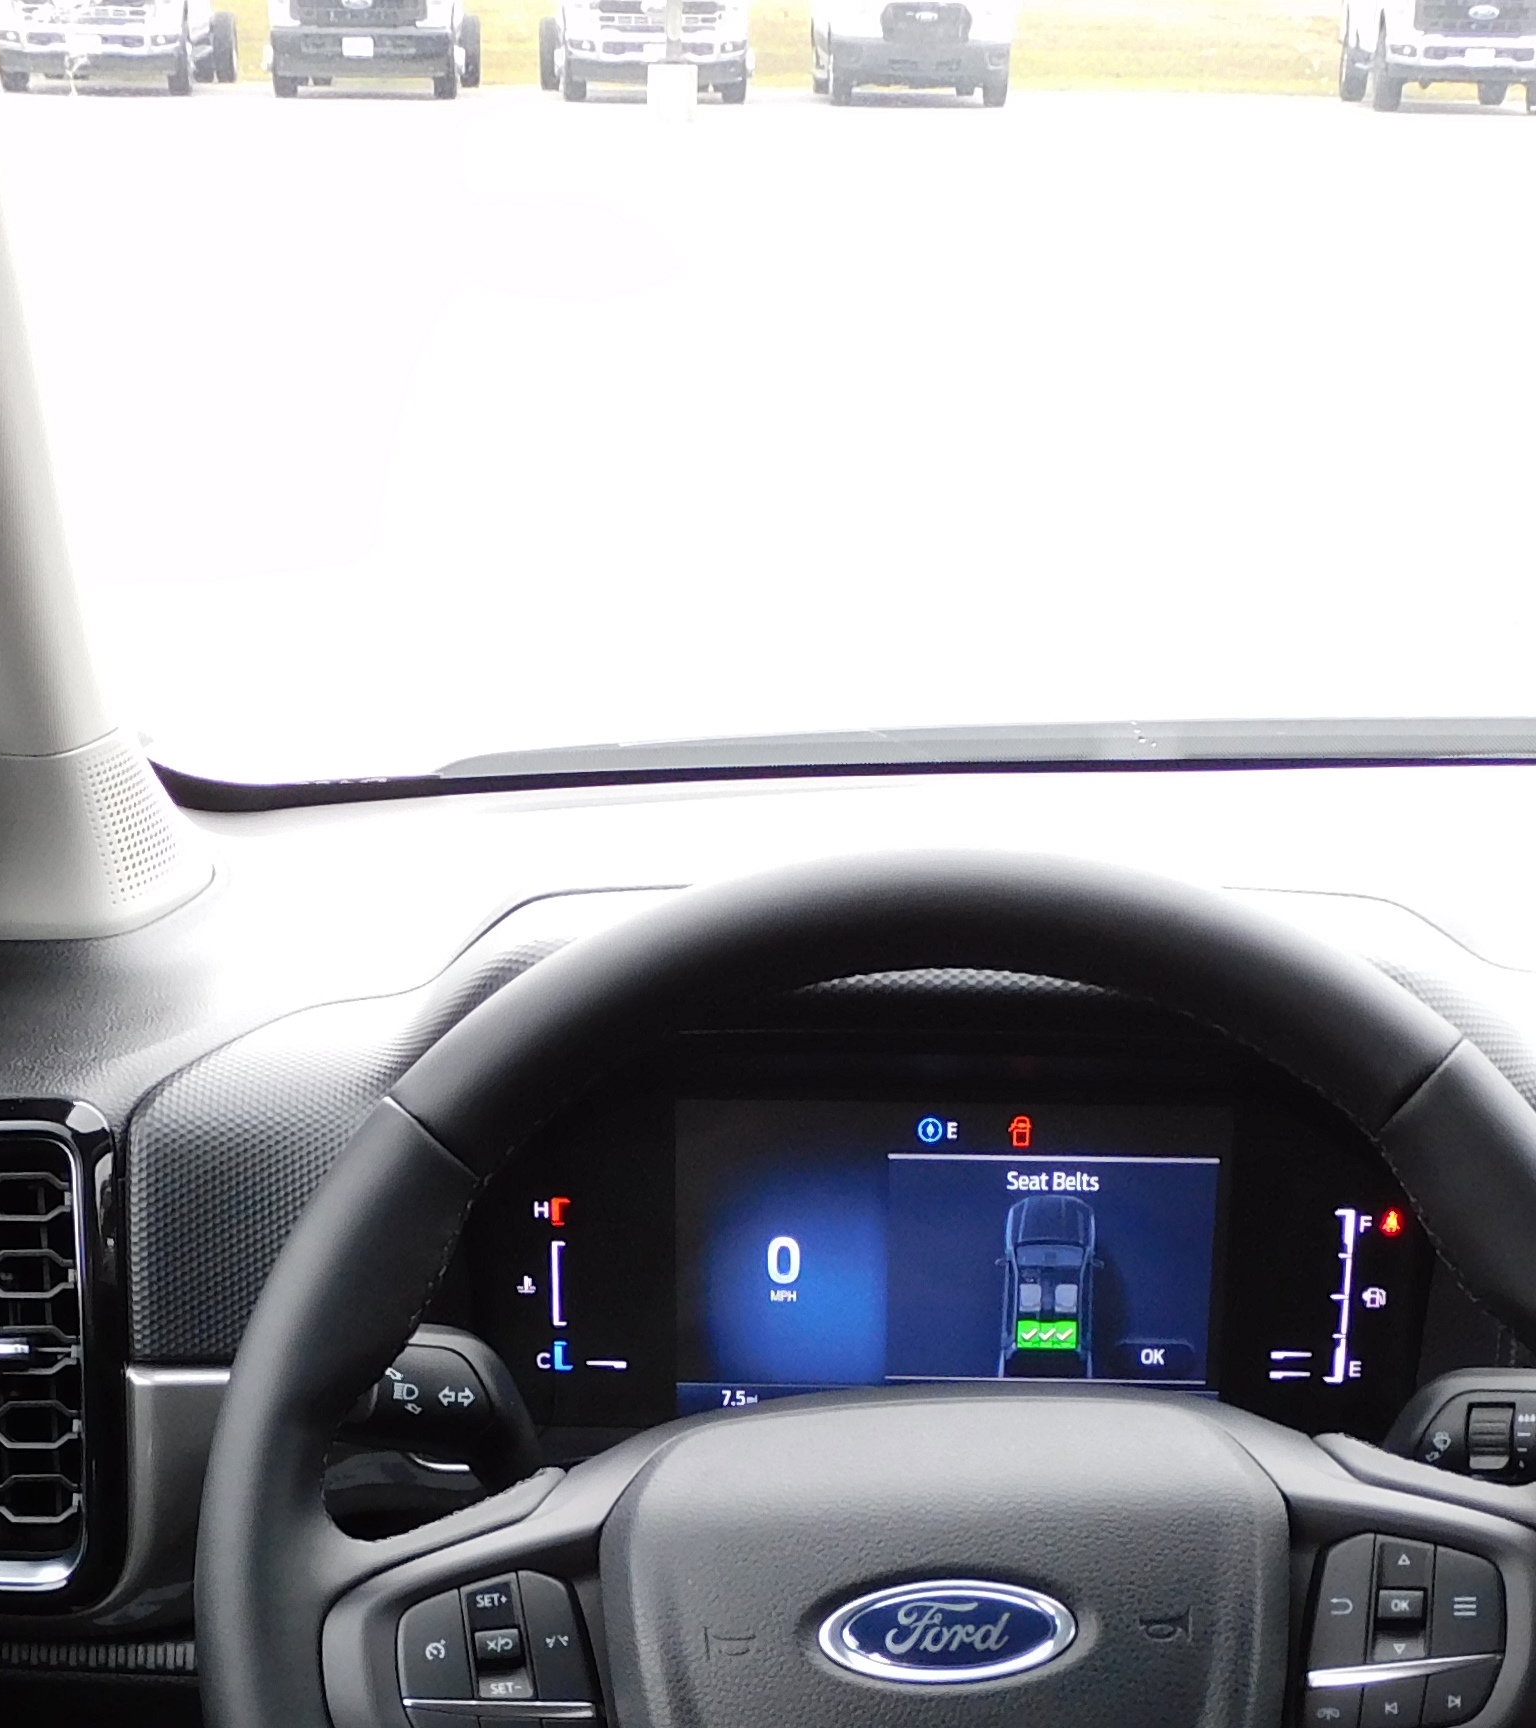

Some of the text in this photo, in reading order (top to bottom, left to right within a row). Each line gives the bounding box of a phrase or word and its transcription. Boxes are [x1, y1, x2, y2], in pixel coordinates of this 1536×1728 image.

[946, 1121, 958, 1140] E
[1006, 1171, 1100, 1191] Seat Belts
[533, 1200, 550, 1219] H
[1359, 1215, 1372, 1233] F
[766, 1235, 802, 1285] 0
[769, 1289, 797, 1303] MPH
[535, 1351, 552, 1370] C
[1140, 1347, 1165, 1366] OK
[1349, 1360, 1361, 1378] E
[1390, 1599, 1410, 1612] OK
[884, 1600, 1011, 1655] Ford
